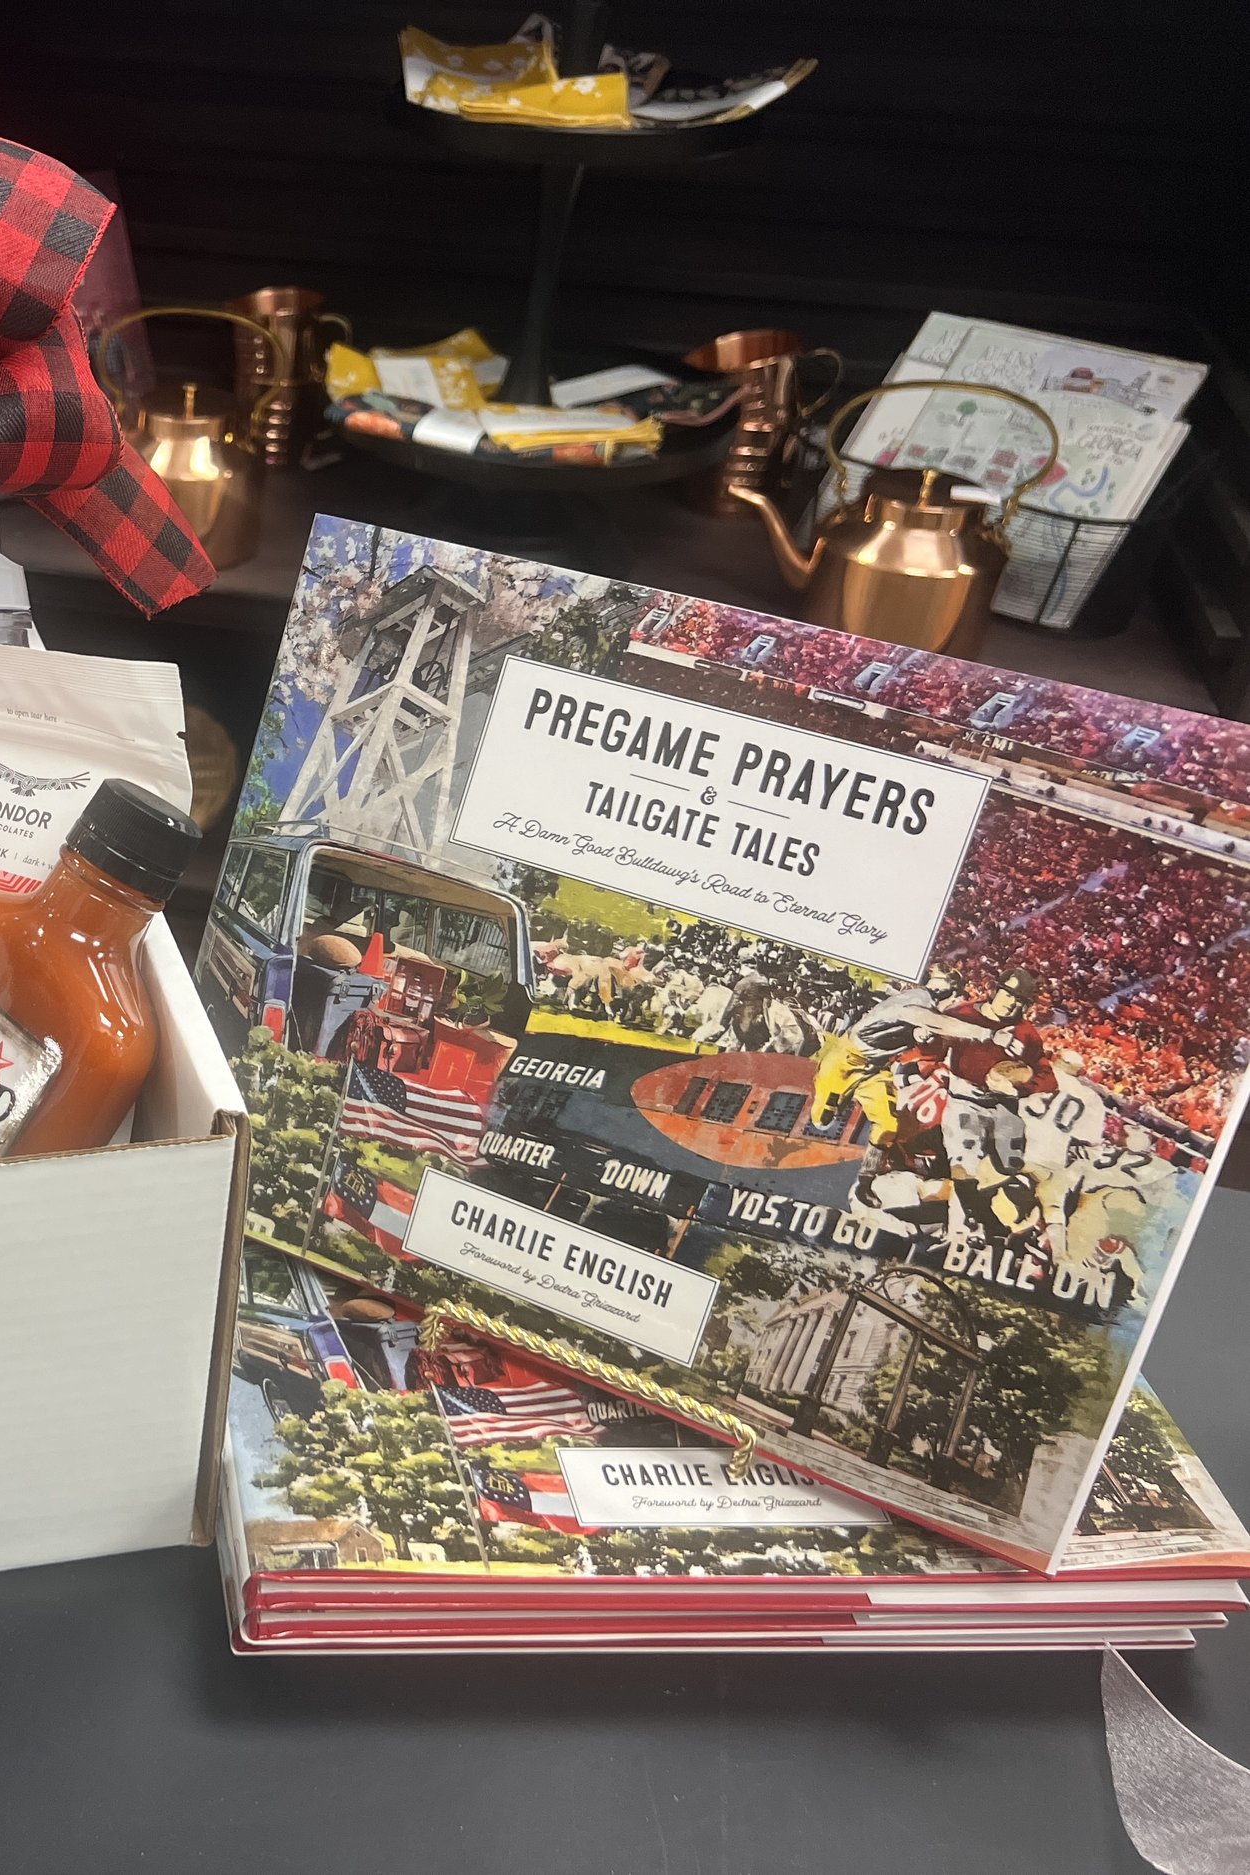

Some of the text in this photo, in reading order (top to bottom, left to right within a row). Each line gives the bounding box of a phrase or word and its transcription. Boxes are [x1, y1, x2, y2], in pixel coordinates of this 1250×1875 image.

[524, 687, 935, 836] PREGAME PRAYERS
[700, 785, 718, 806] &
[22, 855, 40, 867] dark
[584, 781, 820, 877] TAILGATE TALES
[493, 812, 888, 945] A Damn Good Bulldawg's Road to Eternal Glory
[509, 1055, 606, 1089] GEORGIA
[480, 1131, 556, 1169] QUARTER
[599, 1158, 672, 1200] DOWN
[786, 1197, 830, 1238] TO
[831, 1211, 880, 1250] GO
[451, 1200, 673, 1309] CHARLIE ENGLISH
[459, 1241, 642, 1324] Foreword by Dedra Grizzard
[602, 1464, 713, 1486] CHARLIE
[632, 1495, 822, 1511] Foreword by Dedra Grizzard
